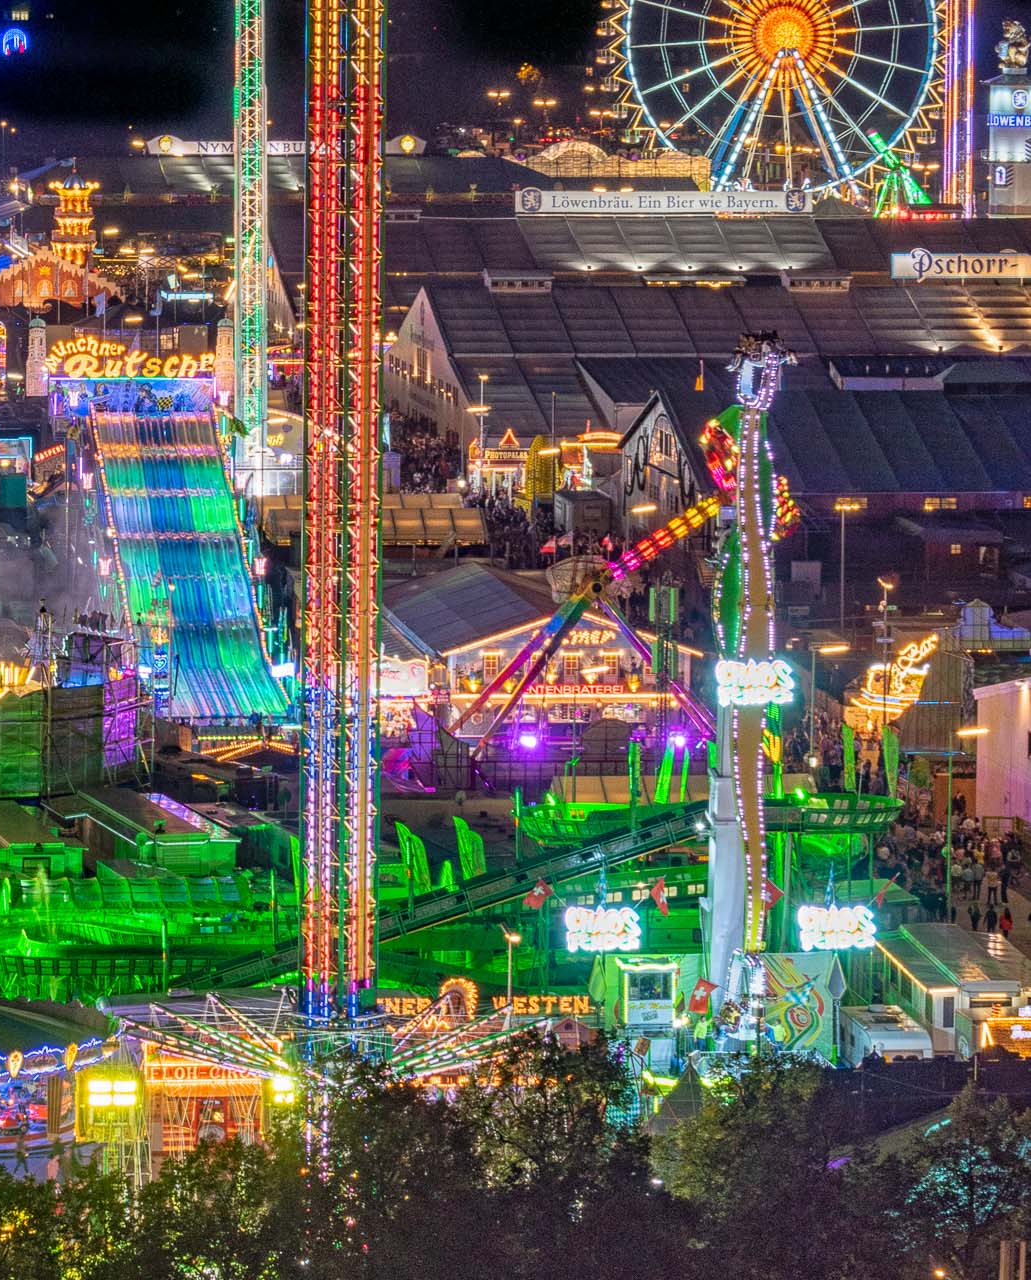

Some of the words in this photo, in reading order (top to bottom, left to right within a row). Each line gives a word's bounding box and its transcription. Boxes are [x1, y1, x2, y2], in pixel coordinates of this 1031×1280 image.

[551, 195, 633, 209] Löwenbräu.
[639, 196, 662, 209] Ein
[667, 195, 696, 209] Bier
[699, 195, 722, 209] wie
[727, 195, 779, 212] Bayern.
[45, 335, 126, 374] Münchner
[526, 684, 624, 695] NTENBRATEREI
[493, 995, 591, 1015] WESTEN
